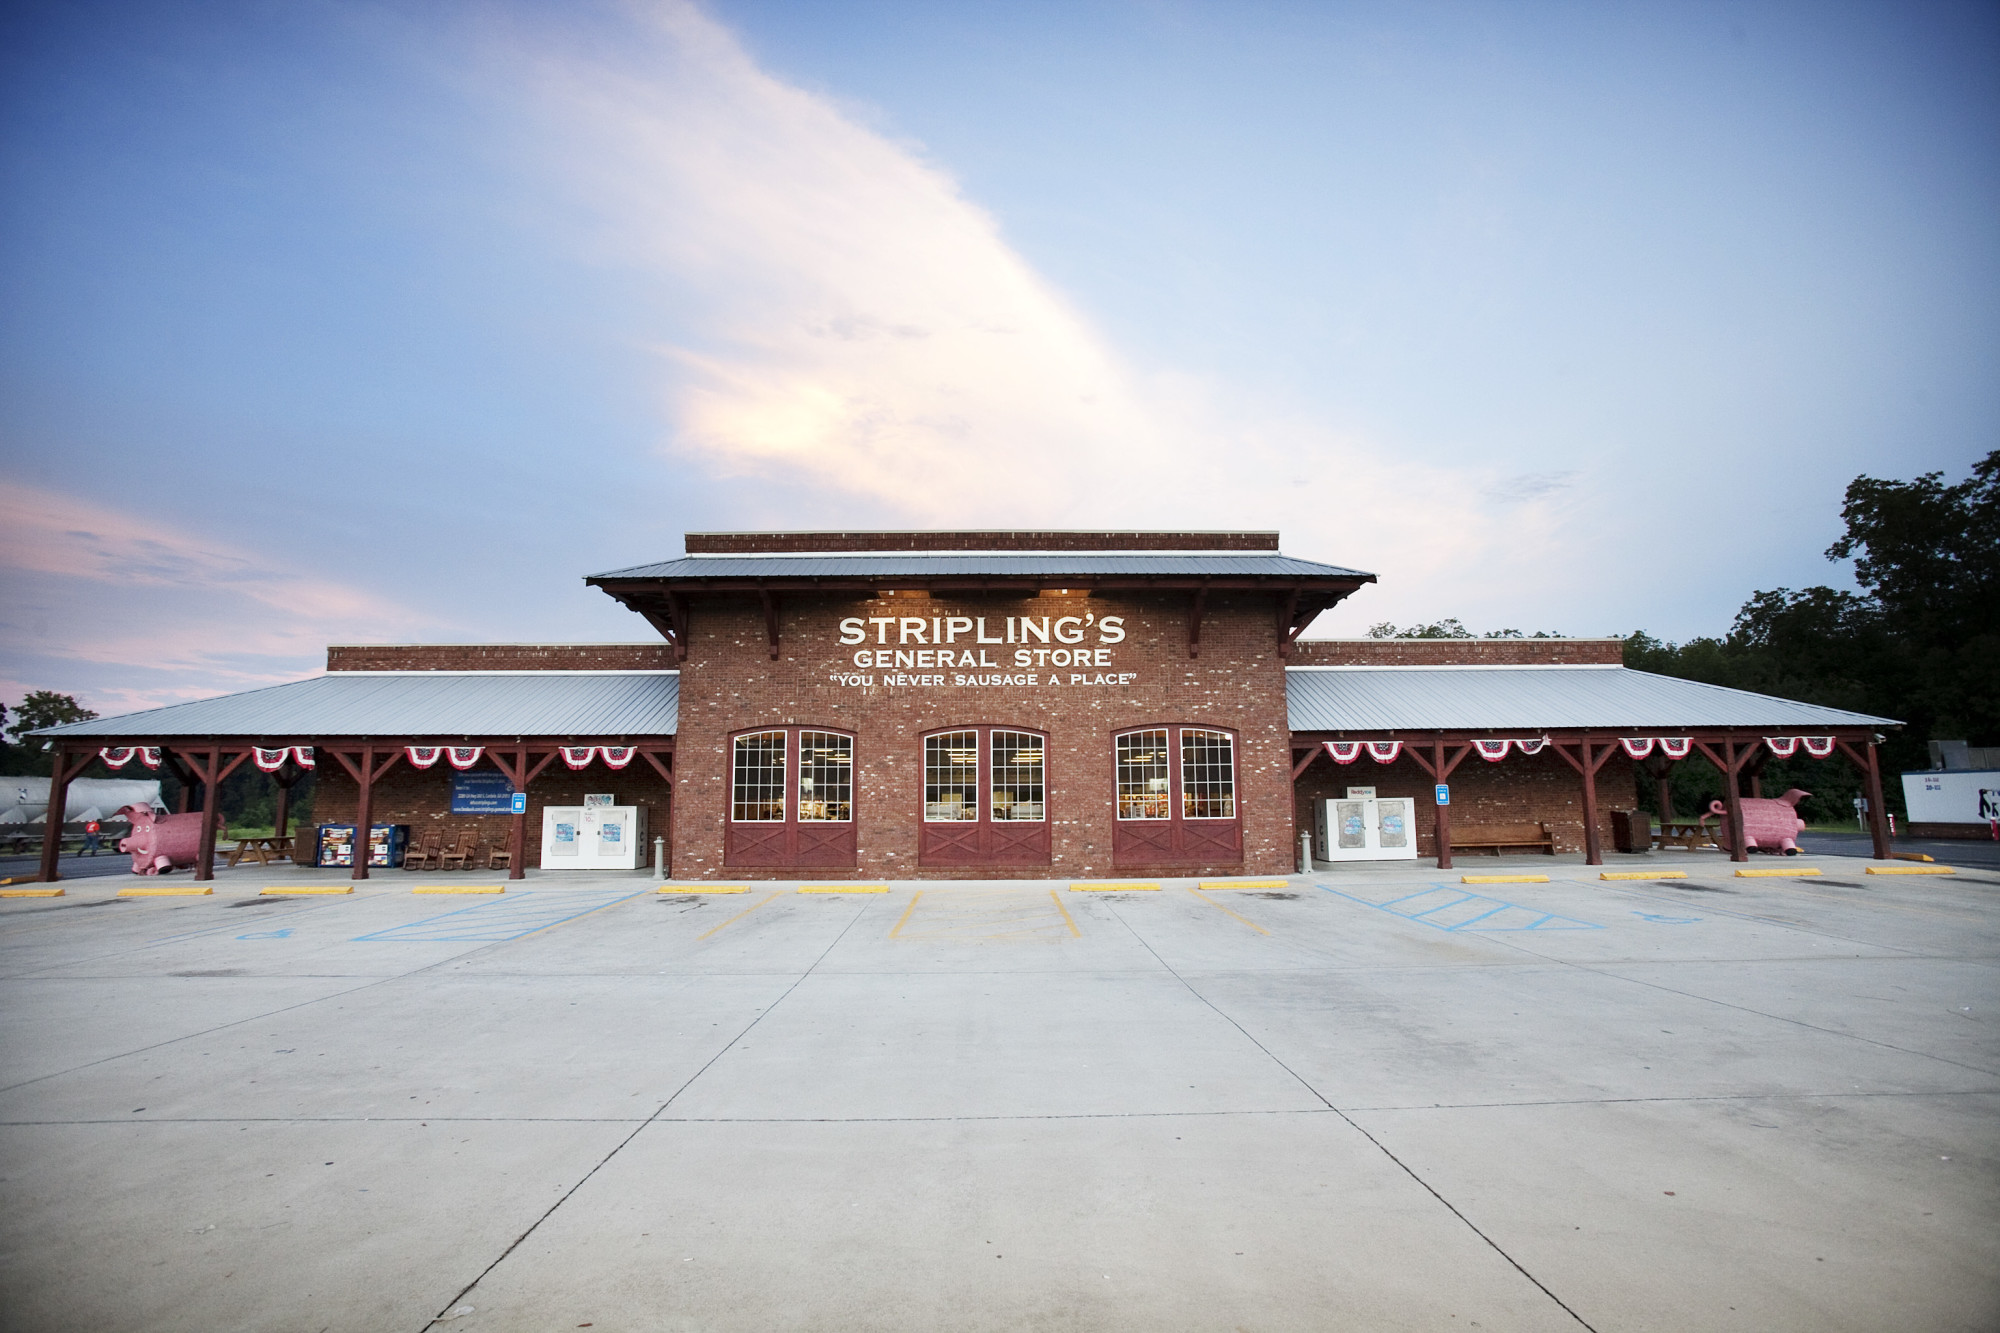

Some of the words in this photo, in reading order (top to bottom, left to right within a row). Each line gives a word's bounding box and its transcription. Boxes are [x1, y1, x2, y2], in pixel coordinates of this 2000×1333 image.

[839, 613, 1126, 645] STRIPLING'S
[854, 649, 997, 668] GENERAL
[1014, 648, 1112, 667] STORE
[883, 674, 945, 686] NEVER
[954, 673, 1039, 686] SAUSAGE
[1048, 674, 1061, 686] A
